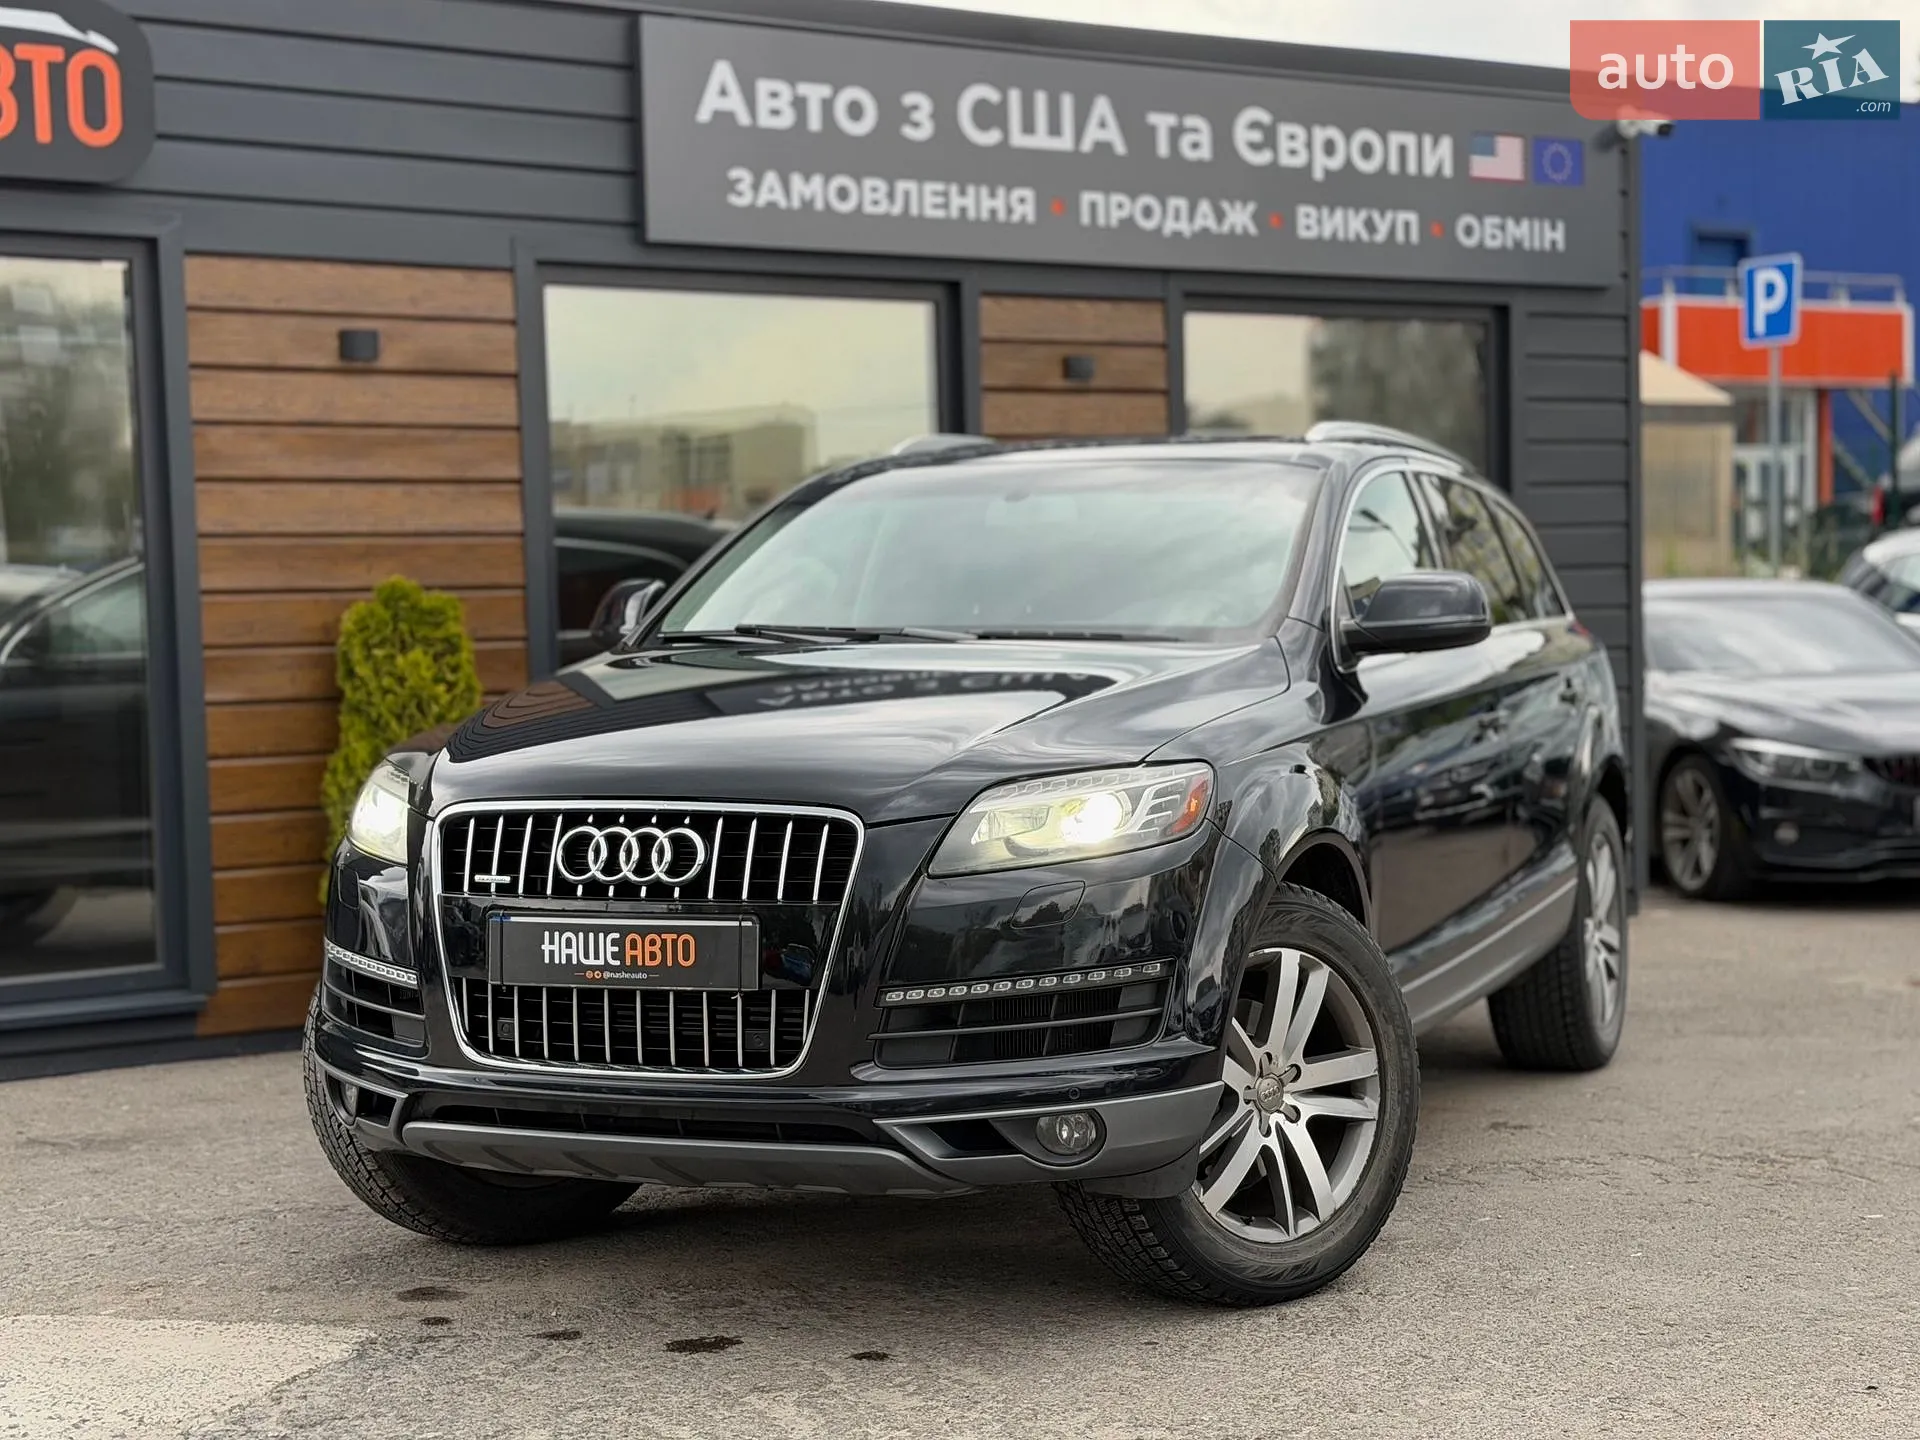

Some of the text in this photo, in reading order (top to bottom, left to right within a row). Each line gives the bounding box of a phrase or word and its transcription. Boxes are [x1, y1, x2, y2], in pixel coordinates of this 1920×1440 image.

[694, 59, 1454, 183] Авто з США та Європи
[726, 166, 1566, 253] ЗАМОВЛЕННЯ ПРОДАЖ ВИКУП ОБМІН
[1753, 267, 1788, 337] P
[541, 930, 696, 968] НАШЕ АВТО
[603, 971, 648, 980] @nasheauto
